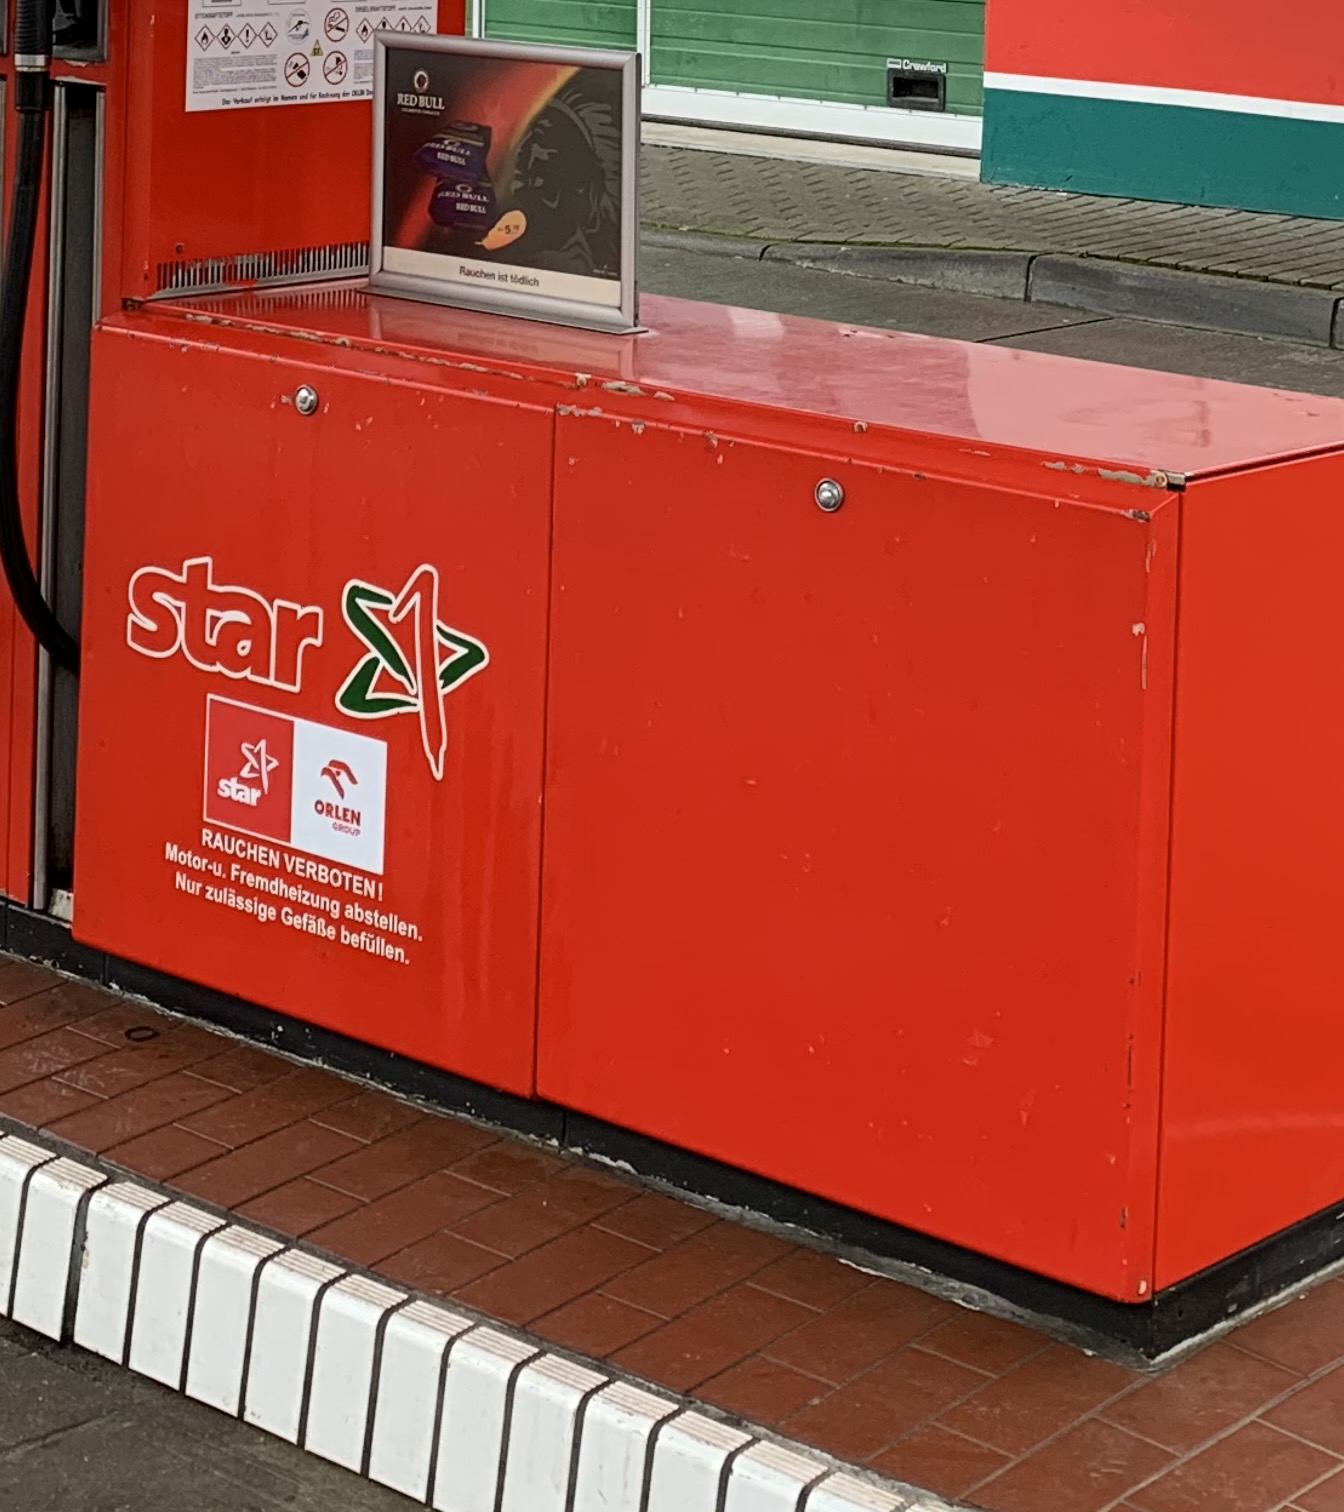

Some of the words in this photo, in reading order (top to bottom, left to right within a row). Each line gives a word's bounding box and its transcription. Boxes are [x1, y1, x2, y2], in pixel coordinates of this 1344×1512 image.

[903, 59, 947, 73] Crawford
[397, 93, 418, 107] RED
[419, 96, 445, 110] BULL
[456, 203, 470, 212] RED
[470, 205, 487, 214] BULL
[459, 265, 496, 280] Rauchen
[498, 272, 508, 282] ist
[510, 273, 539, 287] tödlich
[126, 557, 323, 693] star
[217, 777, 261, 807] star
[314, 799, 361, 826] ORLEN
[332, 822, 361, 837] GROUP
[202, 828, 280, 869] RAUCHEN
[165, 842, 226, 879] Motor-u.
[231, 863, 340, 919] Fremdheizung
[345, 902, 423, 941] abstellen.
[175, 872, 202, 896] Nur
[206, 885, 276, 922] zulässige
[281, 907, 336, 940] Gefäße
[341, 925, 410, 964] befüllen.
